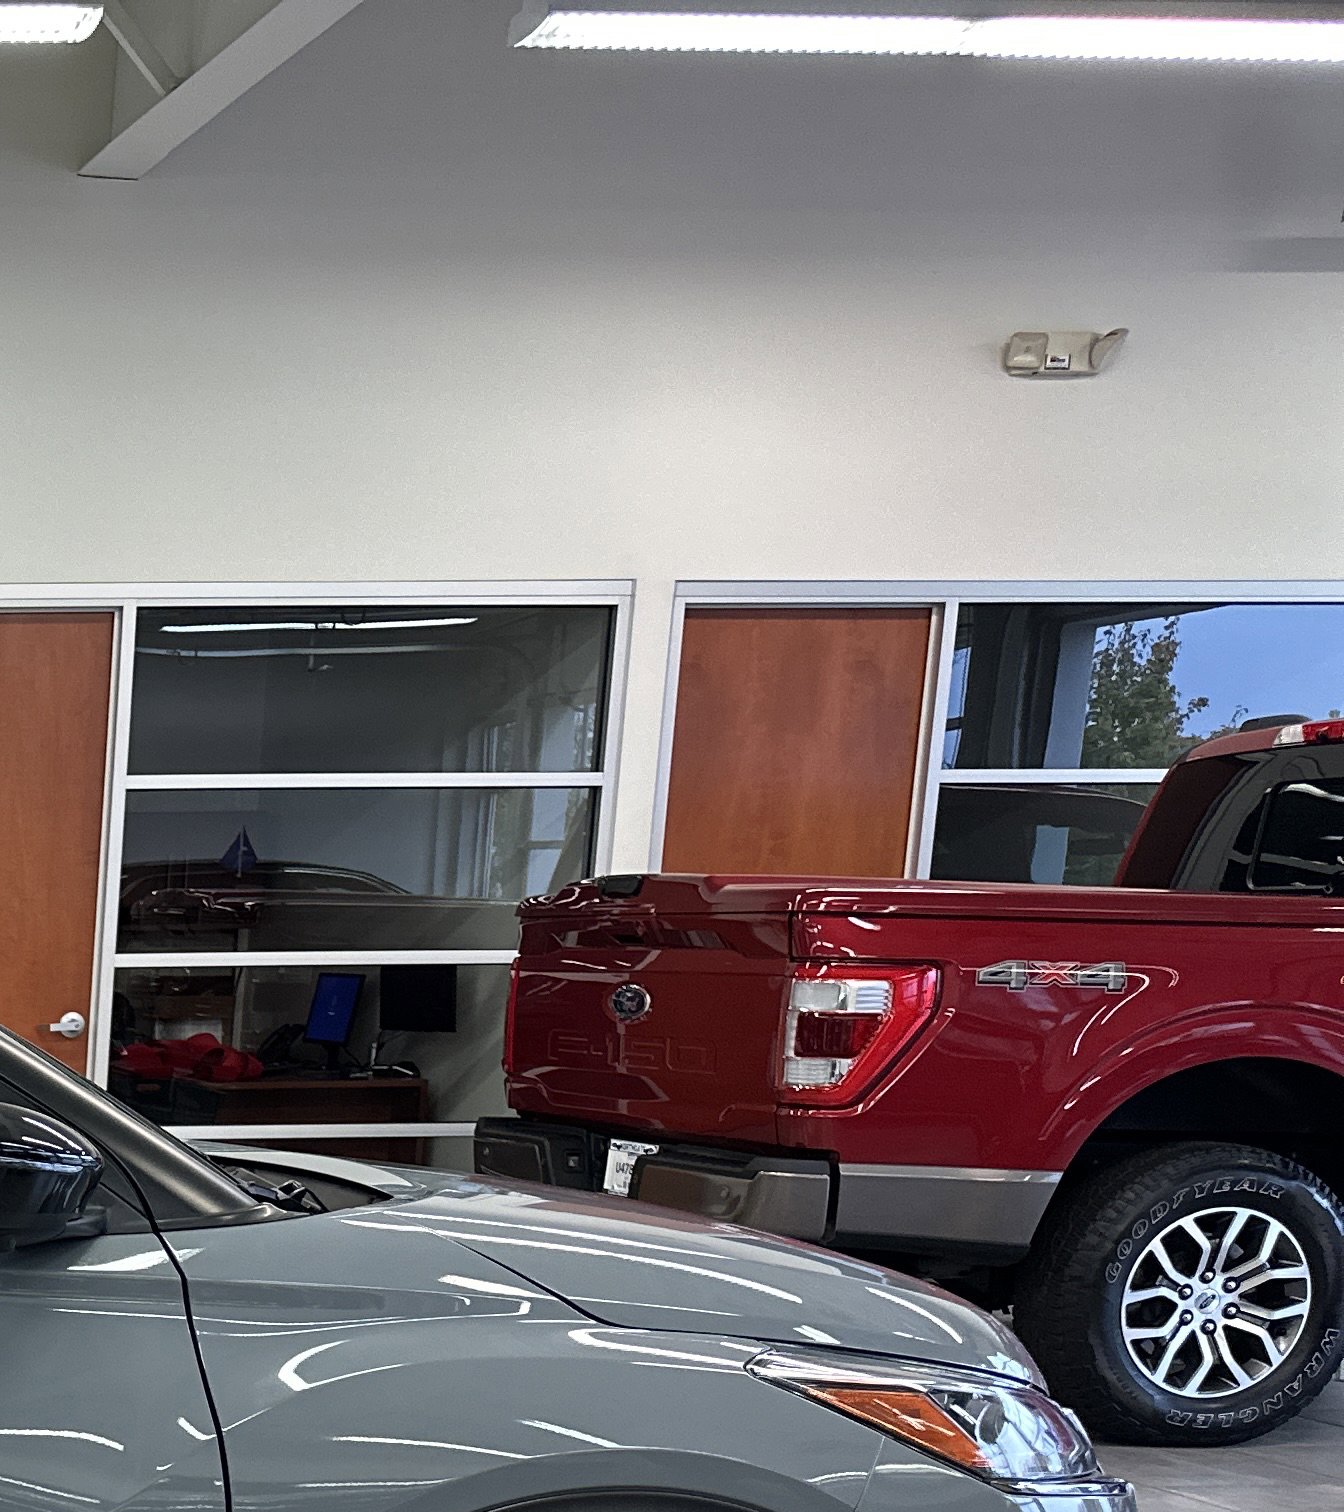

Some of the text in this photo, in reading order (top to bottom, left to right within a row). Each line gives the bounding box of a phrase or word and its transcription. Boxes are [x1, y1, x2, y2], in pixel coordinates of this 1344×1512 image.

[547, 1029, 717, 1075] F-150
[1105, 1176, 1286, 1284] GOODYEAR
[1165, 1327, 1341, 1429] WRANGLER
